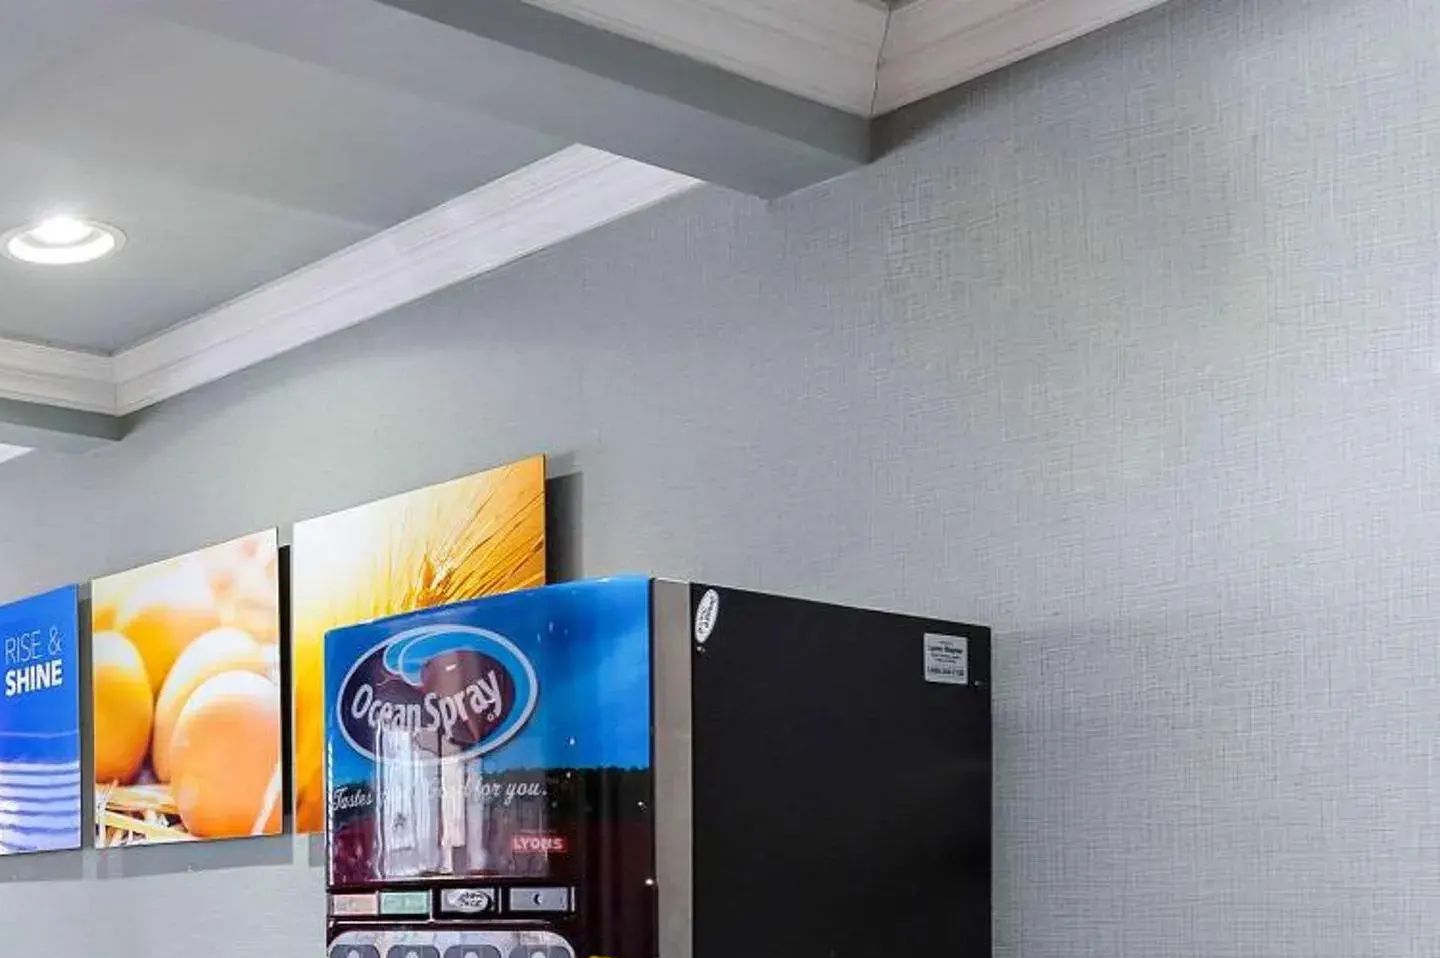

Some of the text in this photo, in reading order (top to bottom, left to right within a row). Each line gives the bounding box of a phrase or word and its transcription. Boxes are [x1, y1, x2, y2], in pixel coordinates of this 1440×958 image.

[5, 624, 62, 665] RISE &
[5, 658, 63, 698] SHINE
[351, 669, 503, 741] Ocean Spray
[332, 787, 373, 812] Tastes
[505, 780, 548, 806] you.
[512, 836, 564, 852] LYONS
